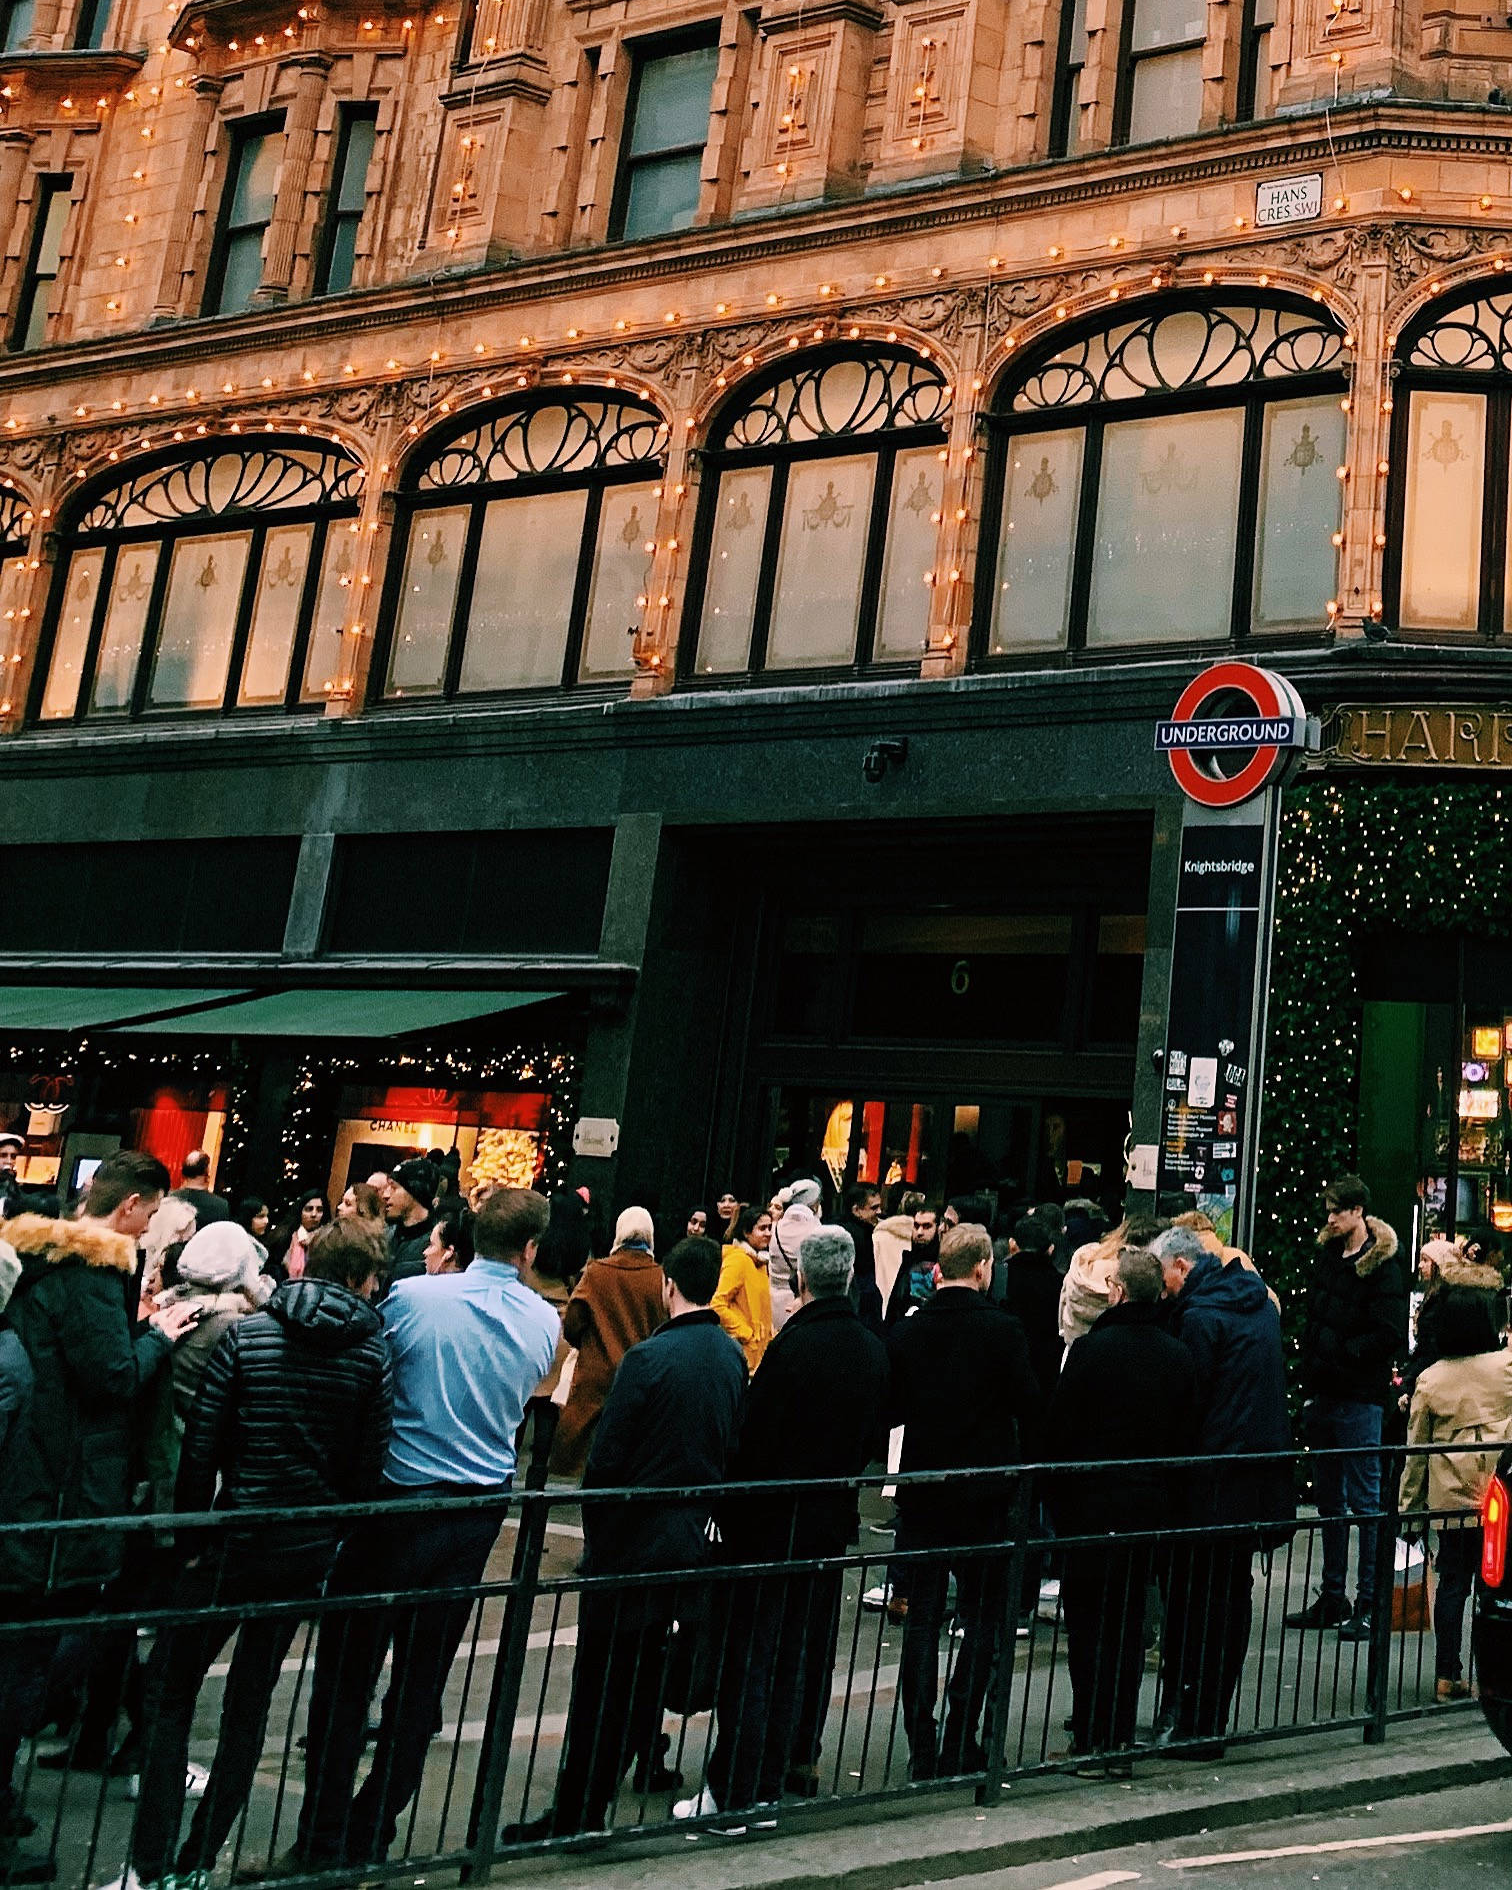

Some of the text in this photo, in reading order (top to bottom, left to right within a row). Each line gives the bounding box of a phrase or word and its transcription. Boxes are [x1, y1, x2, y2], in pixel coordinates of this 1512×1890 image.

[1271, 186, 1308, 205] HANS
[1258, 205, 1291, 222] CRES
[1161, 722, 1290, 744] UNDERGROUND
[1184, 860, 1255, 875] Knightsbridge
[951, 960, 969, 994] 6
[370, 1120, 417, 1135] CHANEL
